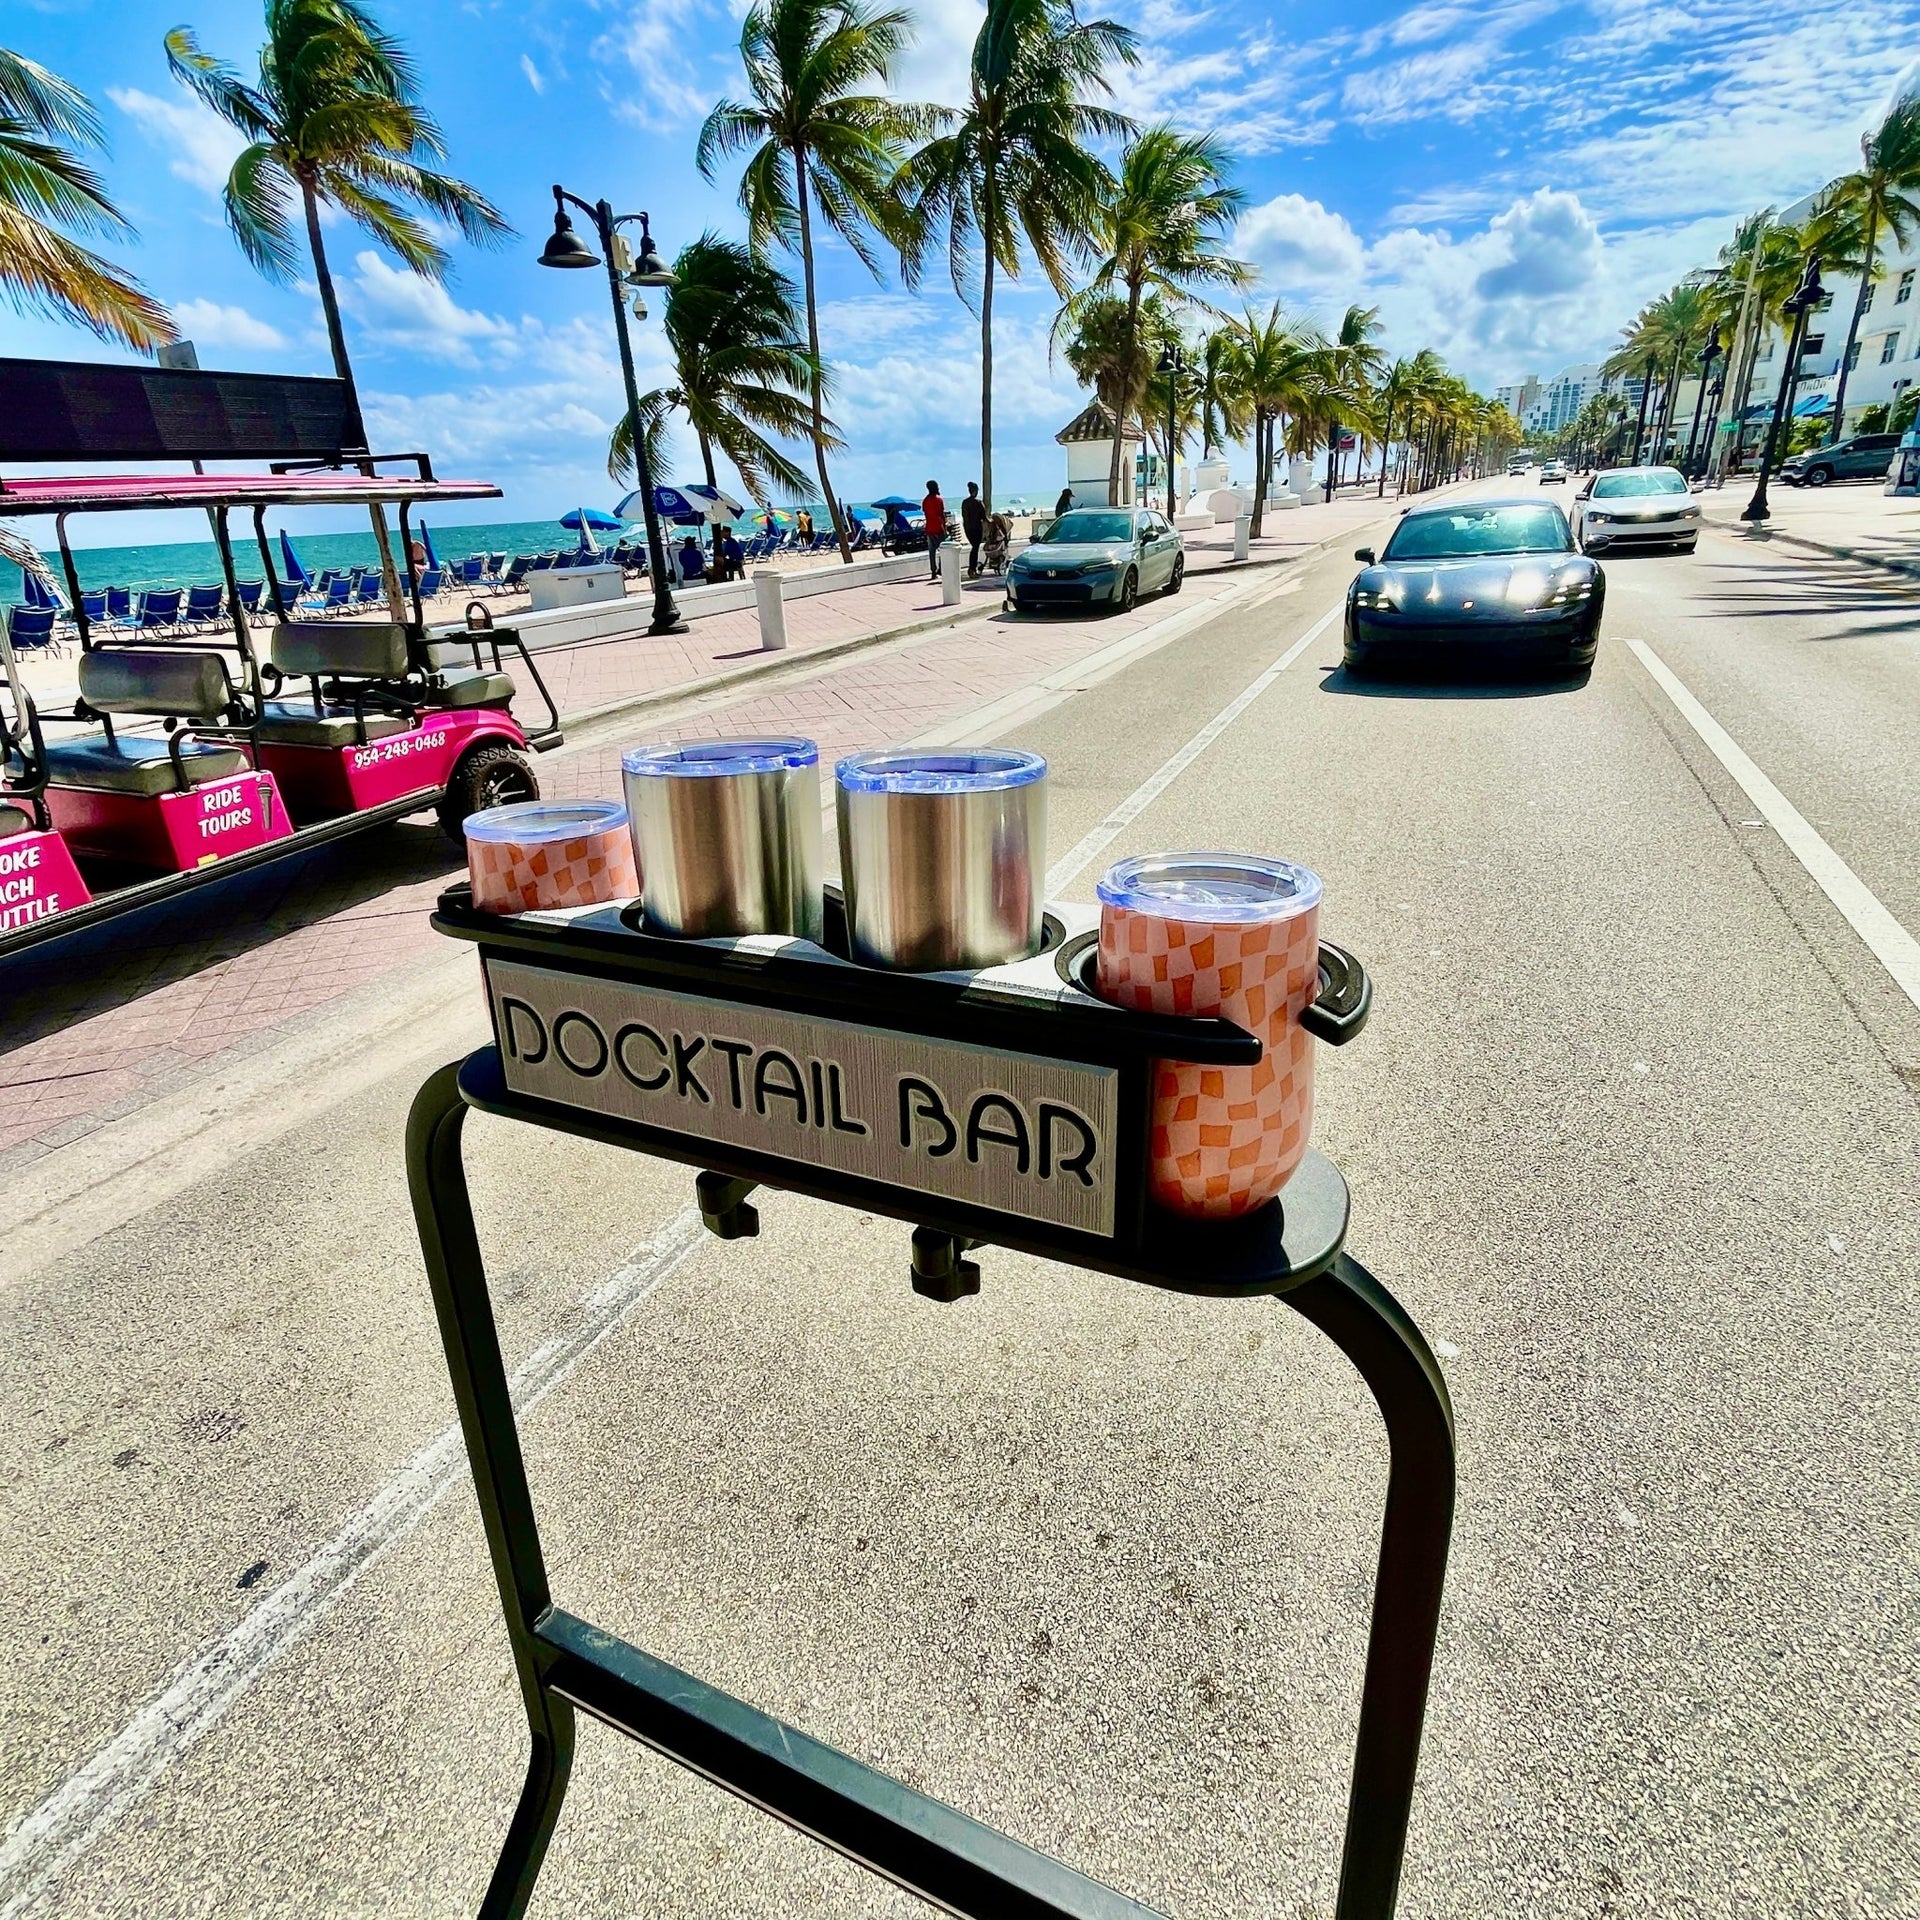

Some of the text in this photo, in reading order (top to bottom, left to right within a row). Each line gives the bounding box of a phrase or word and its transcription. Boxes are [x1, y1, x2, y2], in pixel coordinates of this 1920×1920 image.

[354, 731, 446, 769] 954-248-0468
[202, 785, 243, 813] RIDE
[198, 807, 252, 838] TOURS
[501, 996, 1099, 1188] DOCKTAIL BAR
